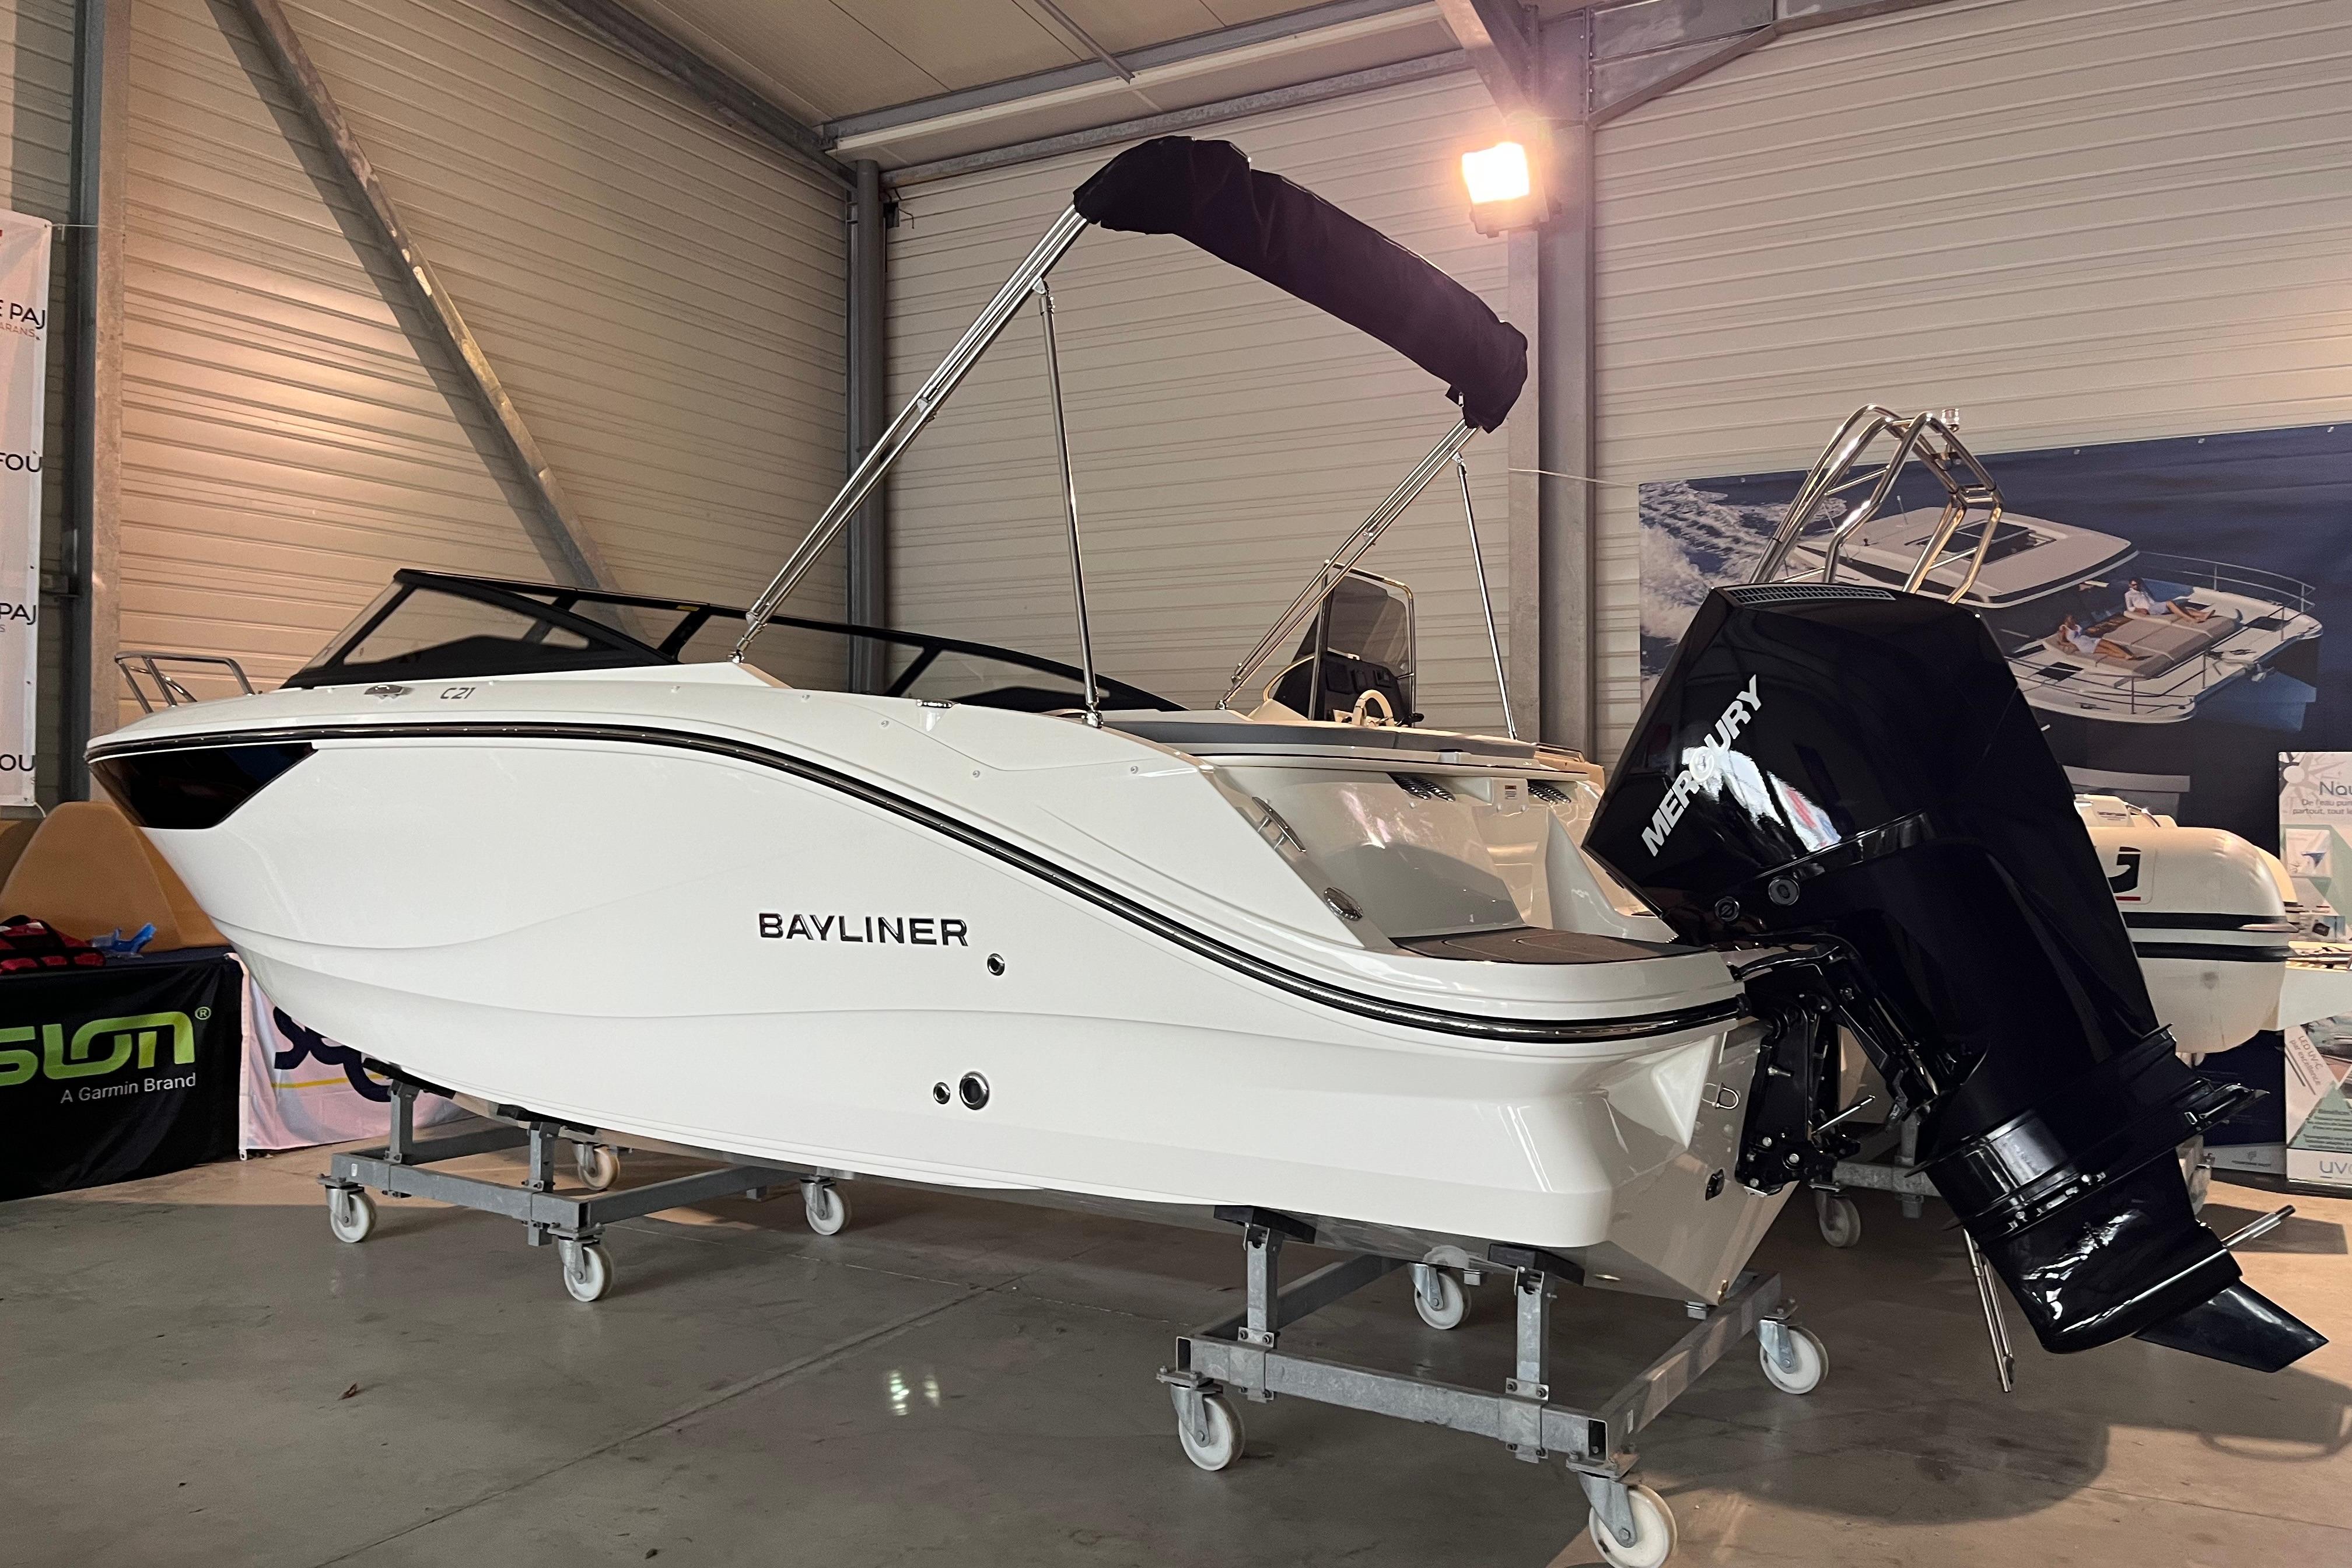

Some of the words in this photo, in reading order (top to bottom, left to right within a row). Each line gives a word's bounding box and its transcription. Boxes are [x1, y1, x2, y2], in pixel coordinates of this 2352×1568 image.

[440, 687, 476, 699] C21
[1641, 674, 1762, 857] MERCURY
[758, 912, 969, 947] BAYLINER
[61, 1090, 74, 1104] A
[78, 1081, 139, 1101] Garmin
[144, 1072, 196, 1093] Brand
